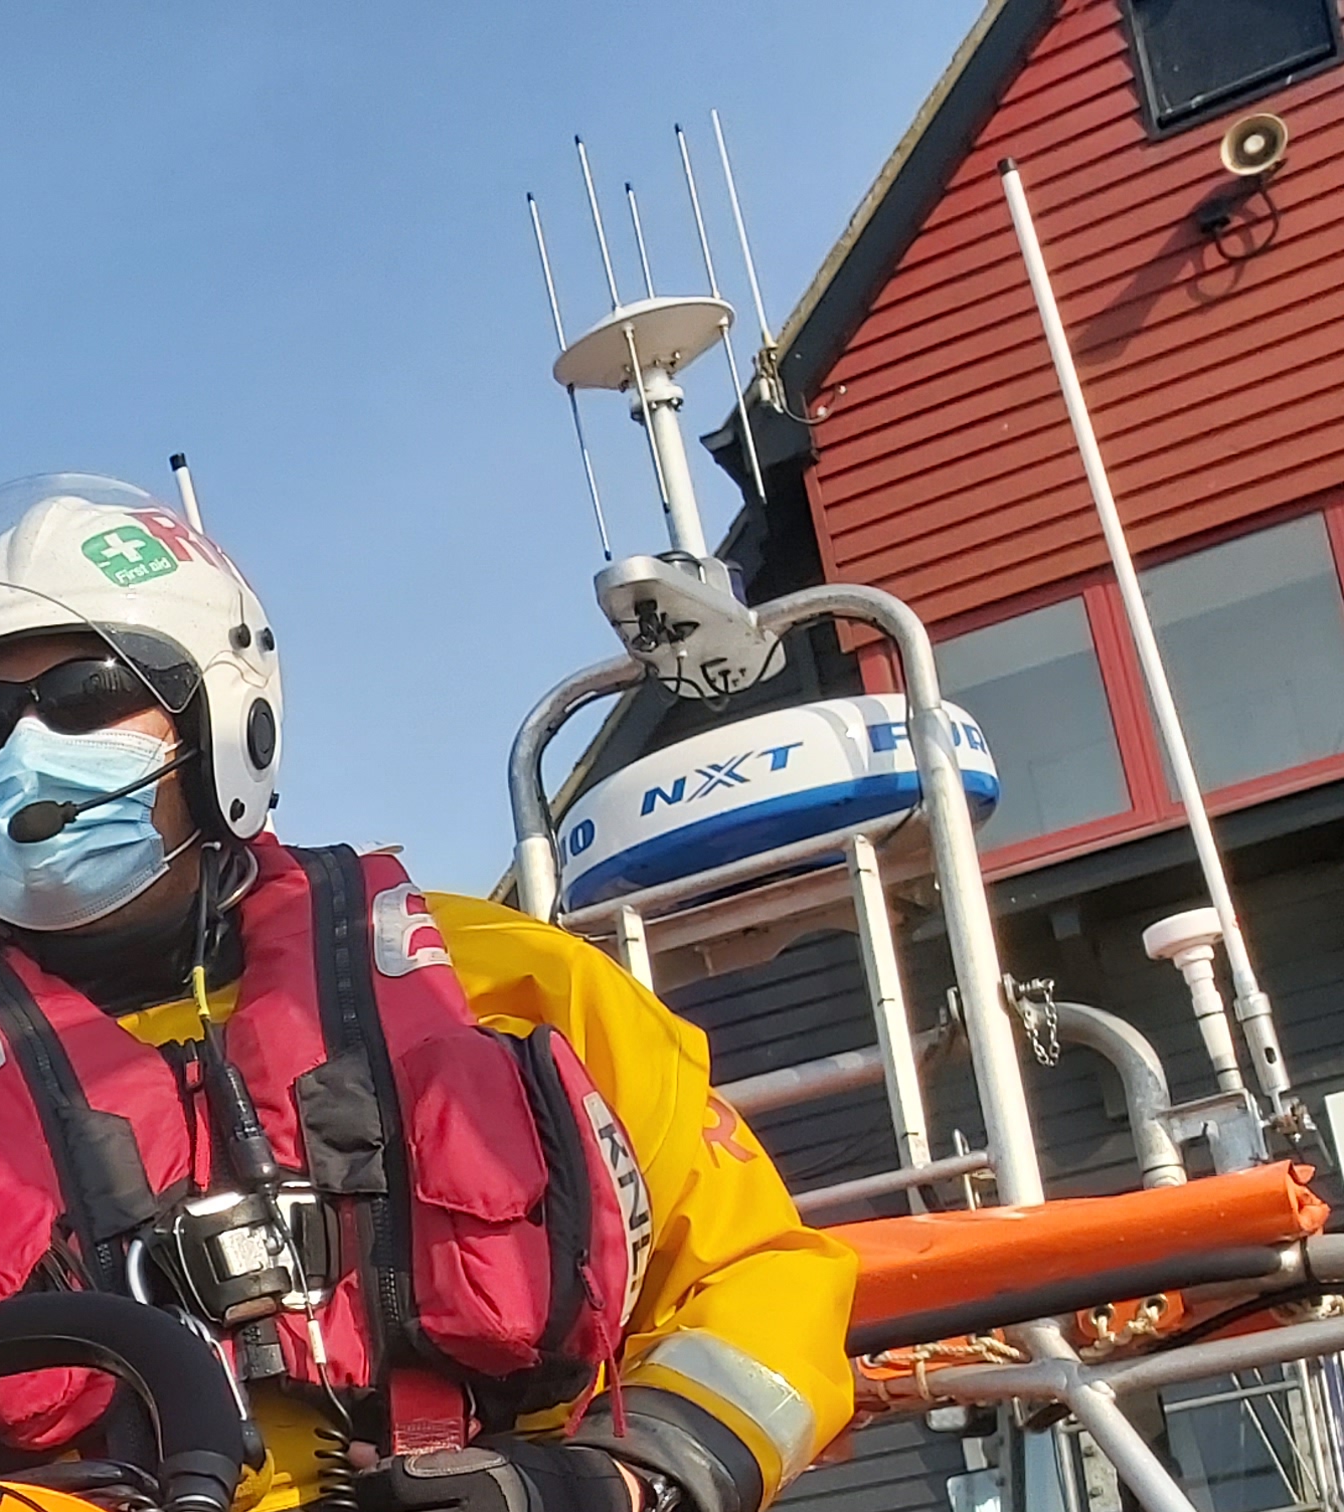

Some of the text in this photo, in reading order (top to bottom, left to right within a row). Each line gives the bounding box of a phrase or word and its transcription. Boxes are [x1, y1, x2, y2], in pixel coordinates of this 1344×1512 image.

[114, 556, 172, 584] First aid
[639, 742, 804, 817] NXT
